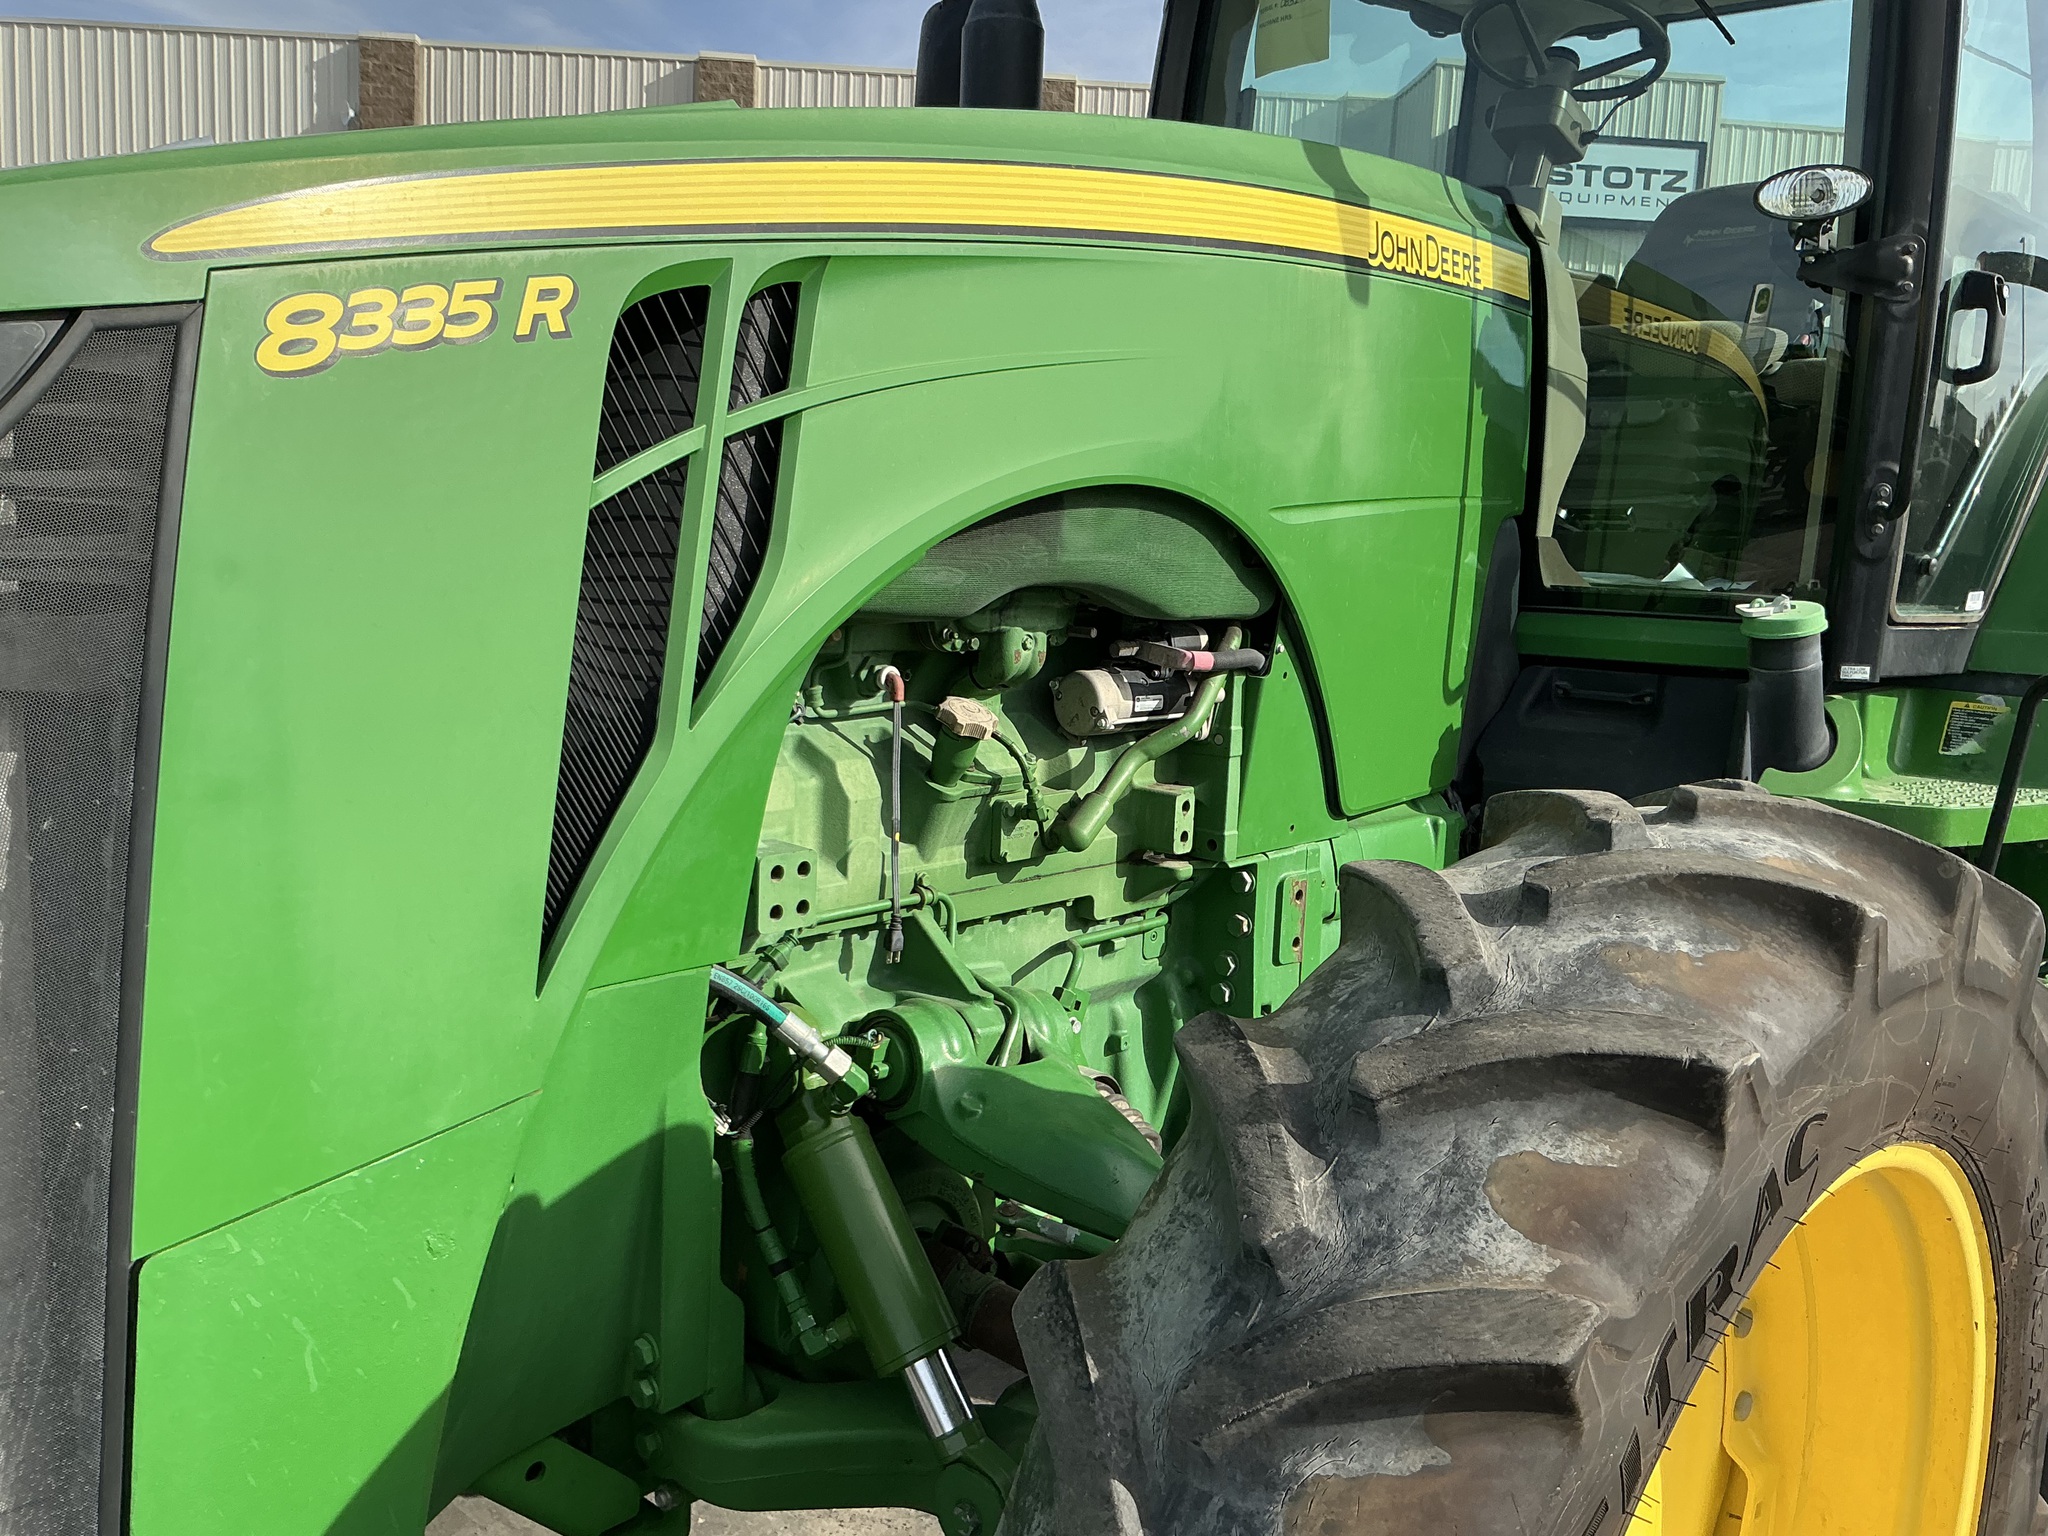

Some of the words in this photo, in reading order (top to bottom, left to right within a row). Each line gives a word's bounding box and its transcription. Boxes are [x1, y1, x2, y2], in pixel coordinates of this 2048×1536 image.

[1549, 163, 1689, 193] STOTZ
[1552, 191, 1669, 207] QUIPMEN
[1368, 220, 1423, 272] JOHN
[1425, 233, 1482, 285] DEERE
[255, 276, 502, 377] 8335
[513, 274, 579, 343] R
